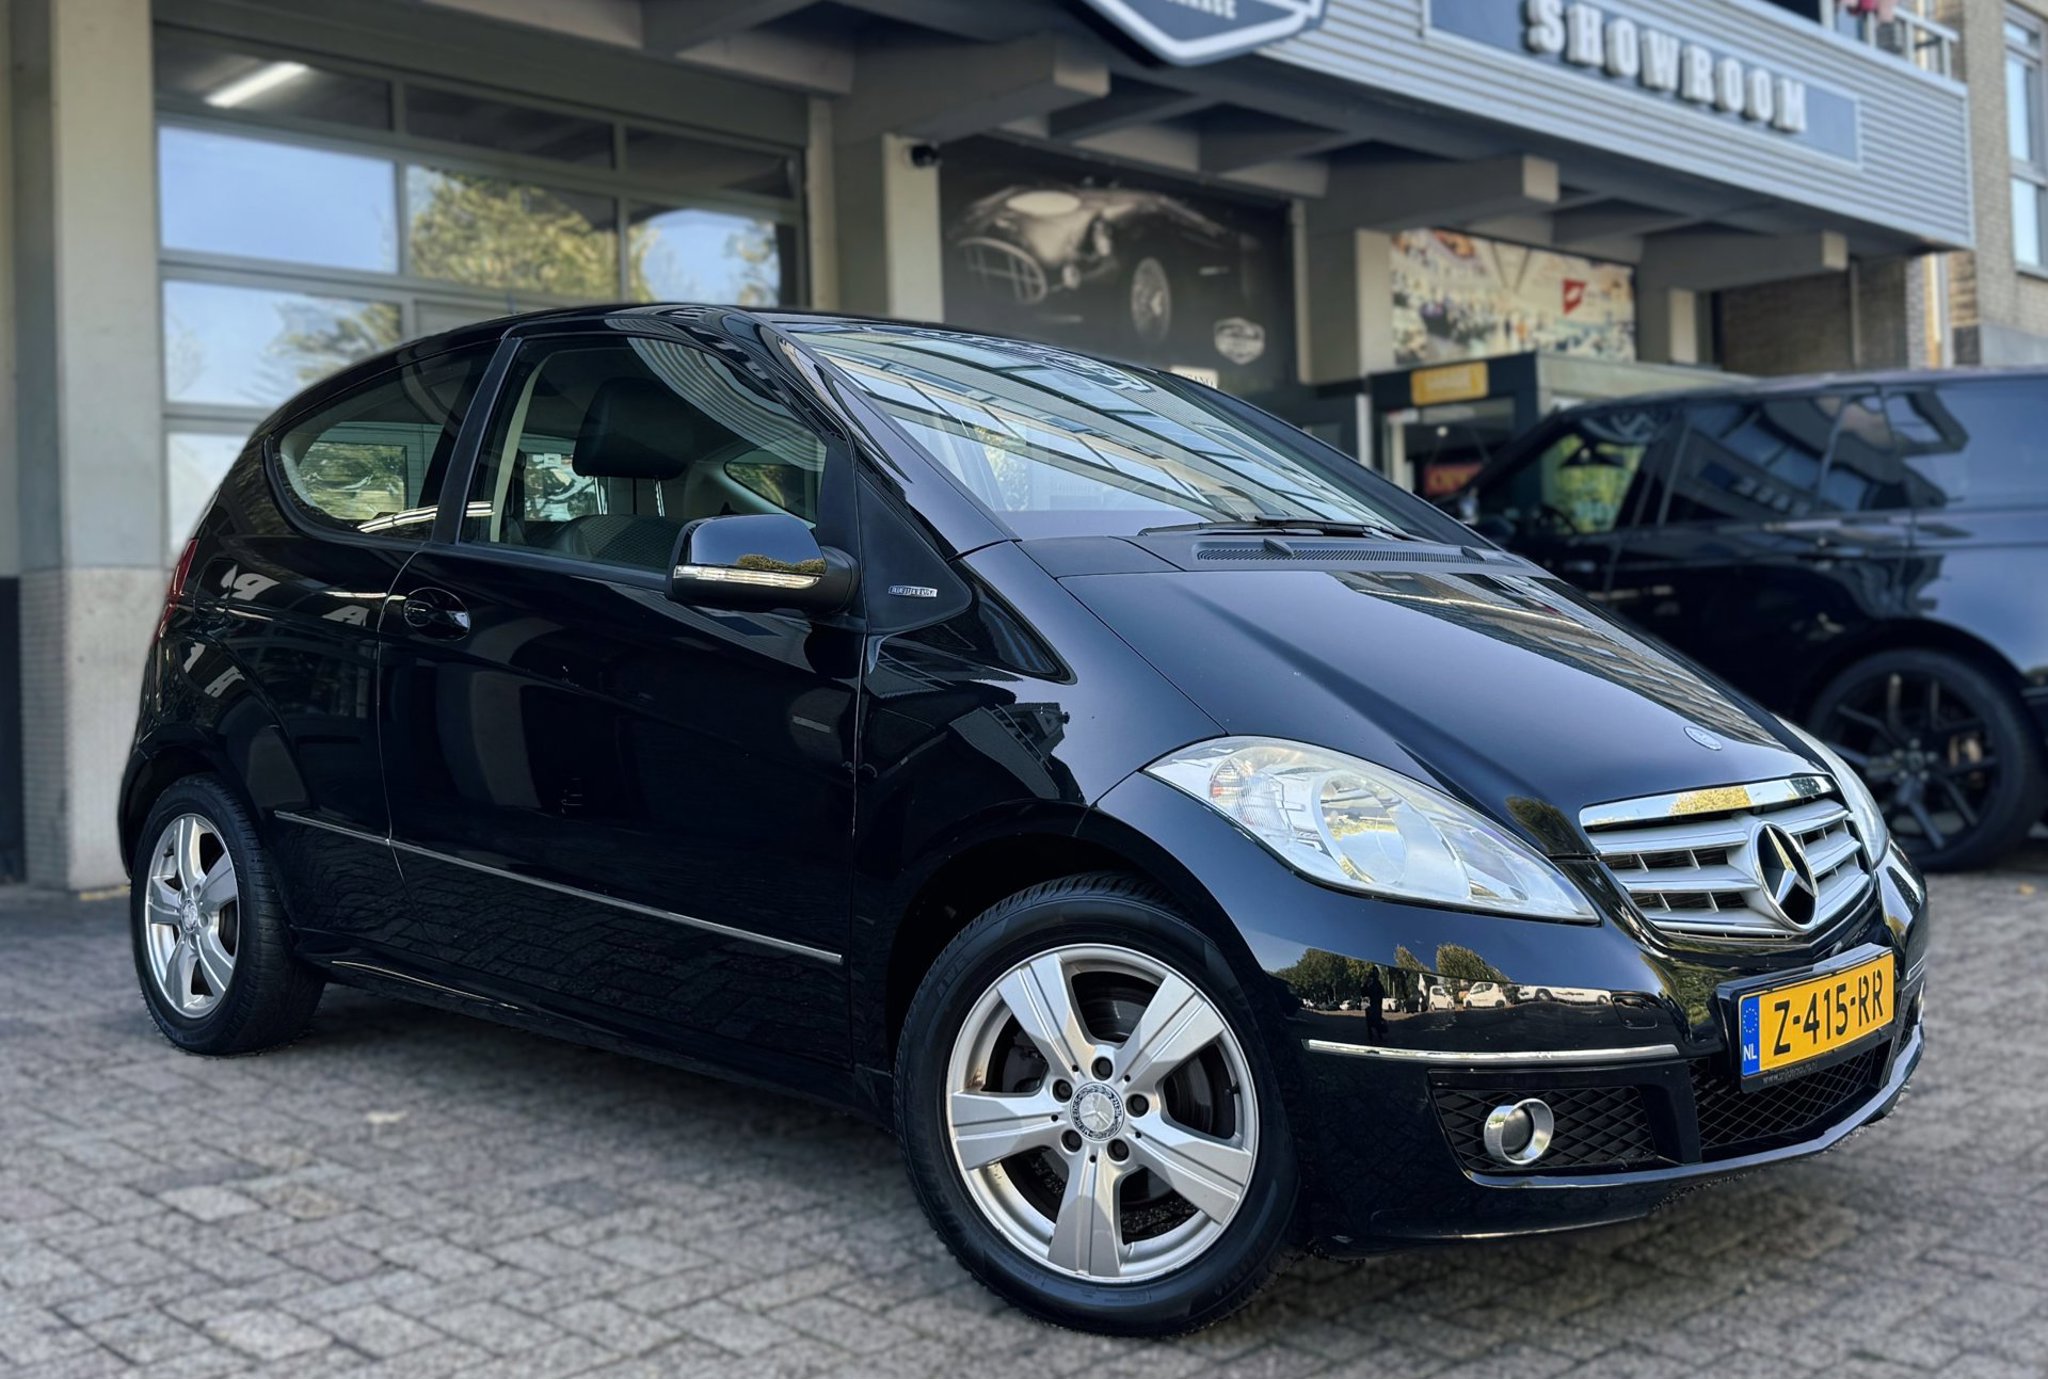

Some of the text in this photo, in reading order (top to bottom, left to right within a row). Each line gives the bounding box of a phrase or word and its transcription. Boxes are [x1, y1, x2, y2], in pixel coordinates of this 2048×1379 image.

[1526, 0, 1806, 132] SHOWROOM
[1743, 1043, 1758, 1061] NL
[1773, 968, 1884, 1056] Z-415-RR
